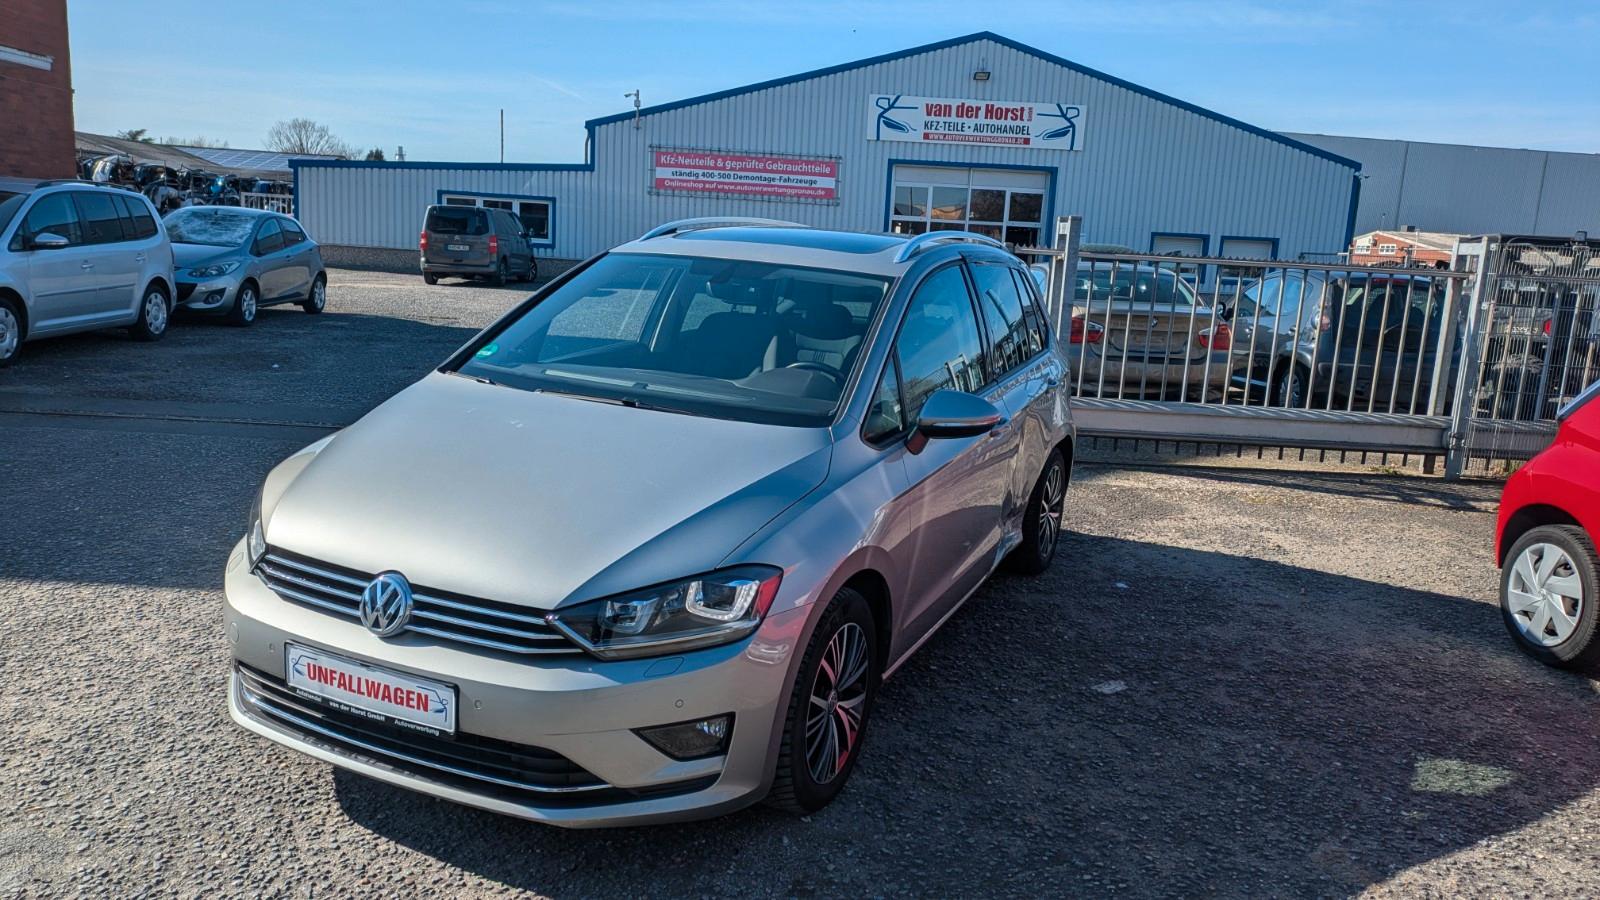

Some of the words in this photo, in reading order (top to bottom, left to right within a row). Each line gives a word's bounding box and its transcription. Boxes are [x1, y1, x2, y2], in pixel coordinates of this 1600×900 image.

[925, 103, 952, 118] van
[956, 102, 981, 119] der
[984, 103, 1025, 121] Horst
[924, 121, 966, 132] KFZ-TEILE
[973, 123, 1031, 136] AUTOHANDEL
[660, 154, 715, 167] Kfz-Neuteile
[716, 158, 724, 167] &
[725, 158, 765, 171] geprüfte
[765, 160, 831, 174] Gebrauchtteile
[664, 179, 704, 189] Onlineshop
[705, 182, 717, 190] auf
[671, 170, 700, 179] ständig
[701, 171, 732, 180] 400-500
[733, 173, 818, 186] Demontage-Fahrzeuge
[306, 662, 430, 713] UNFALLWAGEN
[350, 706, 367, 717] Horst
[367, 711, 386, 722] GmbH
[394, 719, 440, 737] Autoverwertung
